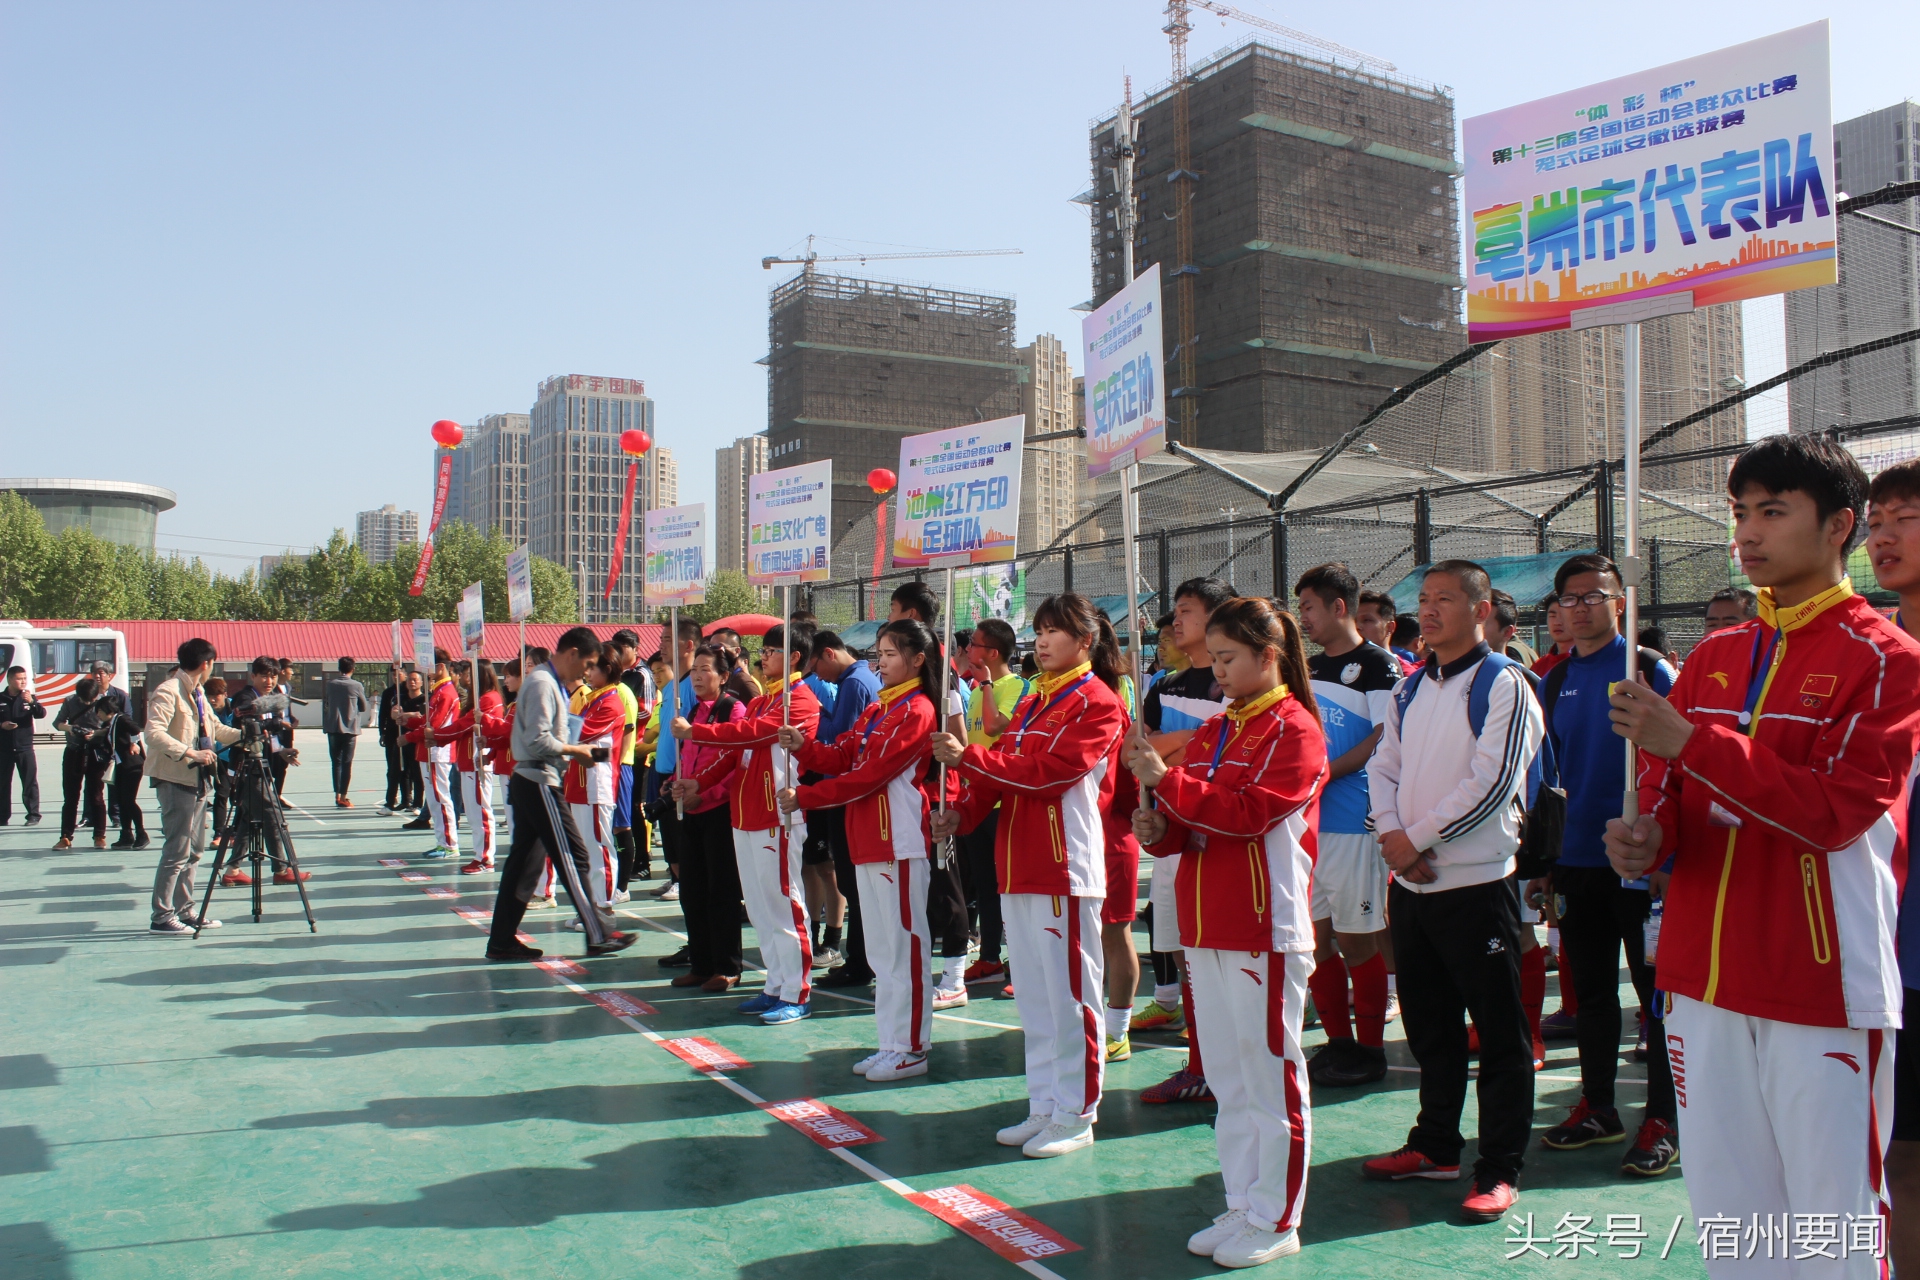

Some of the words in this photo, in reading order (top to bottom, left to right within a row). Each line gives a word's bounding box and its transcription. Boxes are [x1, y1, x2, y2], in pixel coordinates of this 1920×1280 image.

[1492, 75, 1797, 165] 第十三届全国运动会群众比赛
[1535, 110, 1745, 174] 笼式足球安徽选拔赛
[1473, 132, 1830, 283] 亳州市代表队
[568, 374, 645, 395] 环宇国际
[1093, 351, 1154, 439] 安庆足协
[905, 475, 1009, 520] 池州红方印
[922, 516, 983, 555] 足球队
[1795, 601, 1817, 621] CHINA
[1667, 1034, 1687, 1108] CHINA
[923, 1186, 1066, 1258] 宿州市城管执法局
